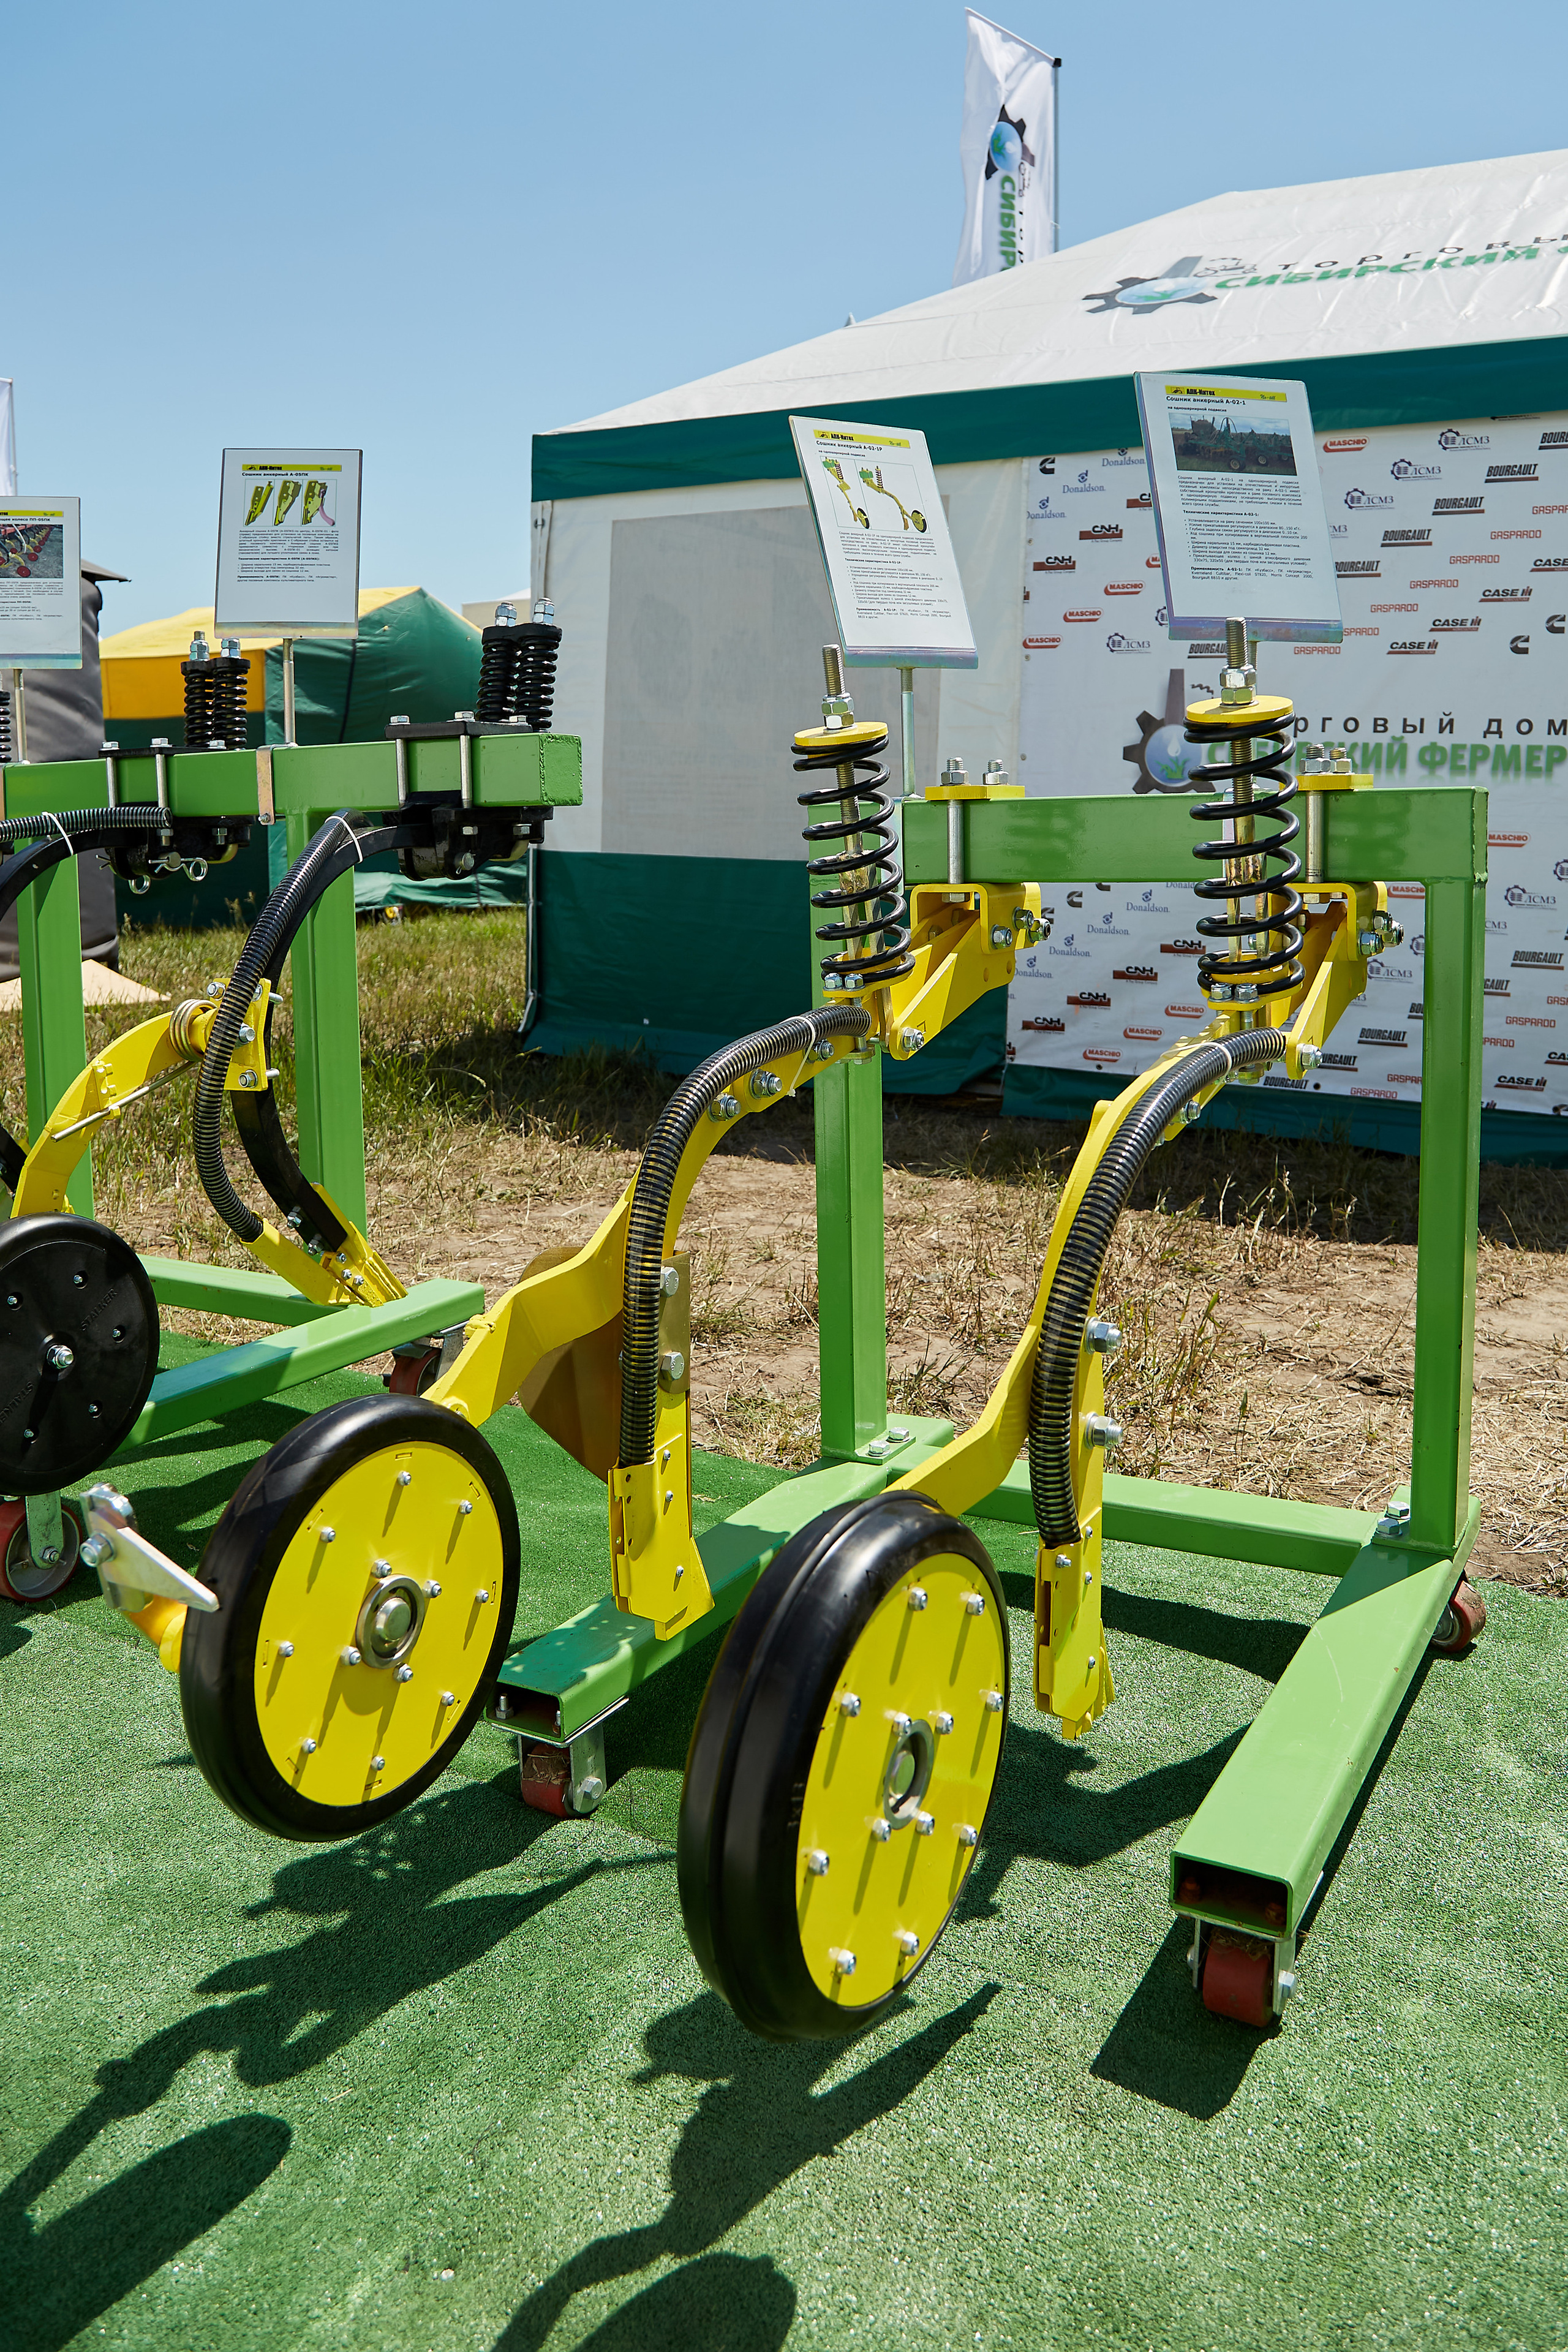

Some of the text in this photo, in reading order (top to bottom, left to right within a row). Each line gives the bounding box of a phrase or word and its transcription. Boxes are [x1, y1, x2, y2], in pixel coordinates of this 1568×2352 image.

[1329, 438, 1367, 447] MASCHIO
[1487, 464, 1539, 477] BOURGAULT
[1433, 497, 1485, 510] BOURGAULT
[1092, 524, 1119, 533] CNH
[1382, 529, 1432, 541] BOURGAULT
[1490, 530, 1542, 540] GASPARDO
[1046, 556, 1072, 564] CNH
[1449, 555, 1500, 564] GASPARDO
[1409, 579, 1459, 589] GASPARDO
[1482, 589, 1519, 597] CASE
[1371, 603, 1419, 612] GASPARDO
[1432, 618, 1469, 627] CASE
[1344, 627, 1380, 636] SPARDO
[1189, 643, 1227, 654] BOURGAU
[1390, 641, 1425, 650] CASE
[1294, 646, 1341, 655] GASPARDO
[1418, 742, 1568, 772] ФЕРМЕР
[1174, 939, 1202, 948] CNH
[1512, 950, 1564, 964] BOURGAULT
[1126, 966, 1154, 975] CNH
[1079, 992, 1107, 1001] CNH
[1170, 1005, 1205, 1014] MASCHIO
[1035, 1017, 1061, 1025] CNH
[1506, 1016, 1556, 1028] GASPARDO
[1128, 1027, 1162, 1036] MASCHIO
[1359, 1028, 1408, 1041] BOURGAULT
[1088, 1049, 1121, 1058] MASCHIO
[1263, 1076, 1309, 1090] BOURGAULT
[1498, 1075, 1534, 1085] CASE
[1350, 1087, 1398, 1099] GASPARDO
